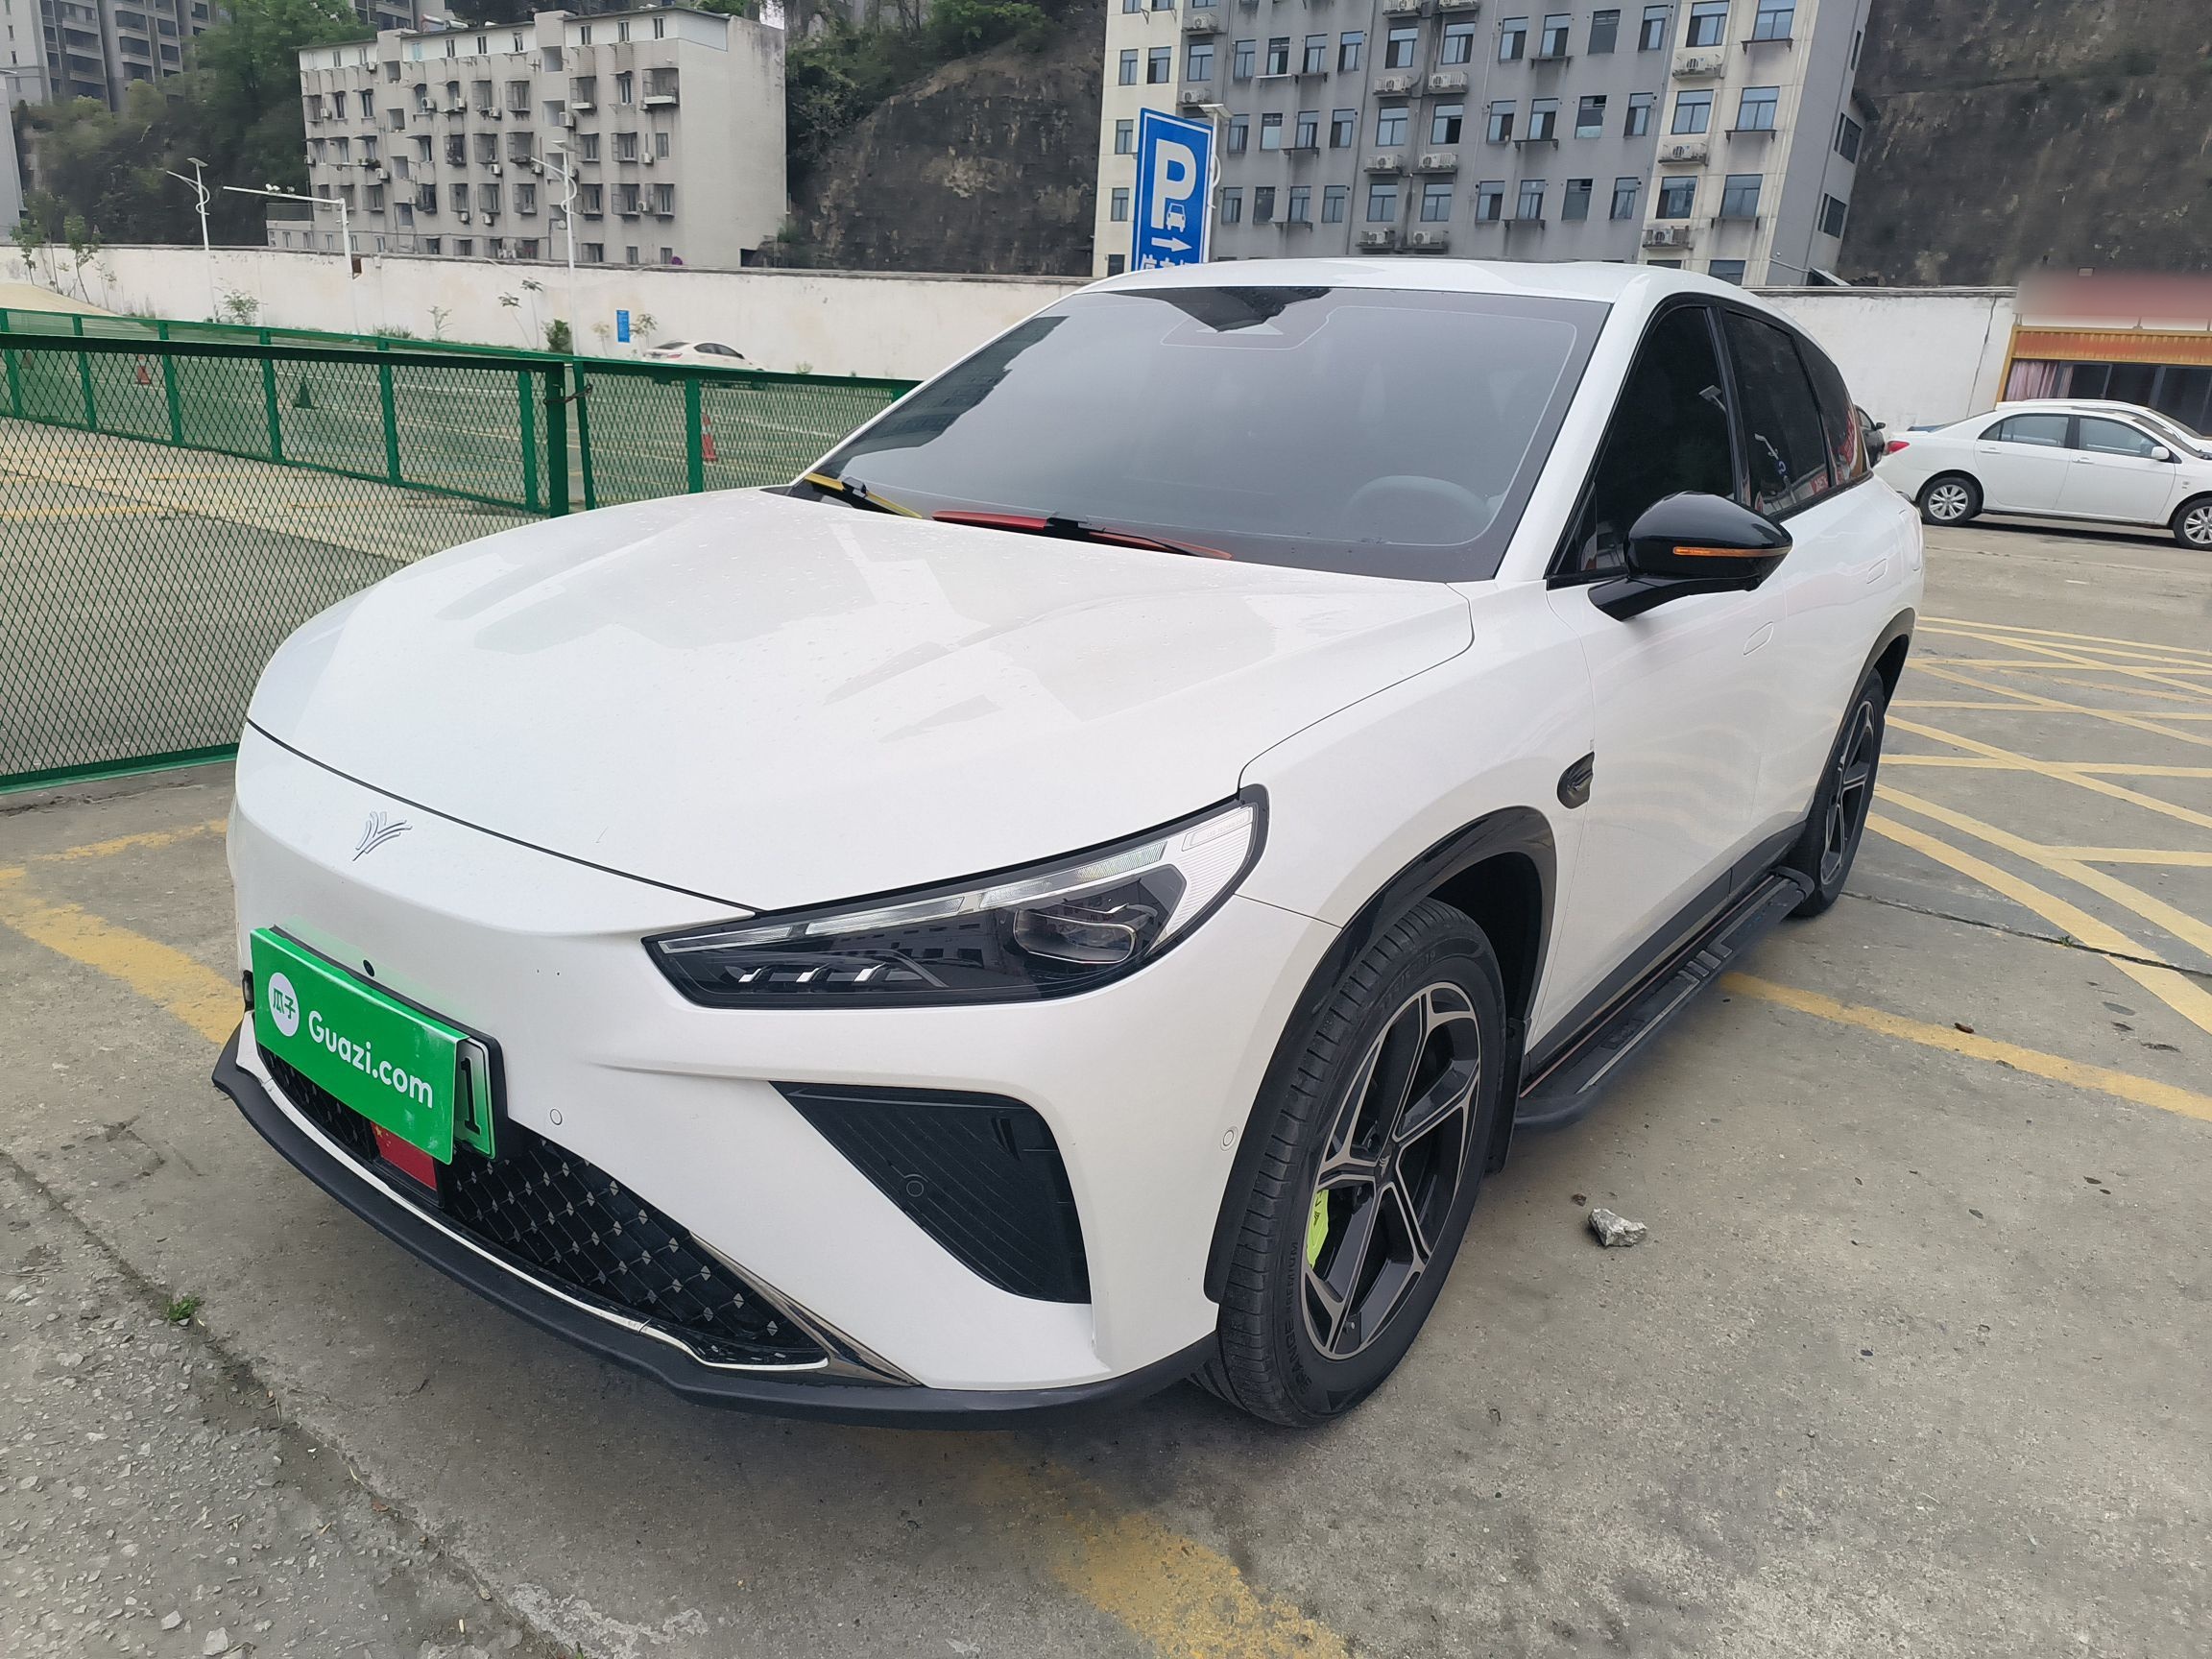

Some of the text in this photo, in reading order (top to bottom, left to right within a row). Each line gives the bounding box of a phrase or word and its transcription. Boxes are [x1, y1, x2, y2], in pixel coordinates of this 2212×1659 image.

[1150, 138, 1197, 229] P
[273, 988, 297, 1020] 瓜子
[308, 1010, 434, 1109] Guazi.com
